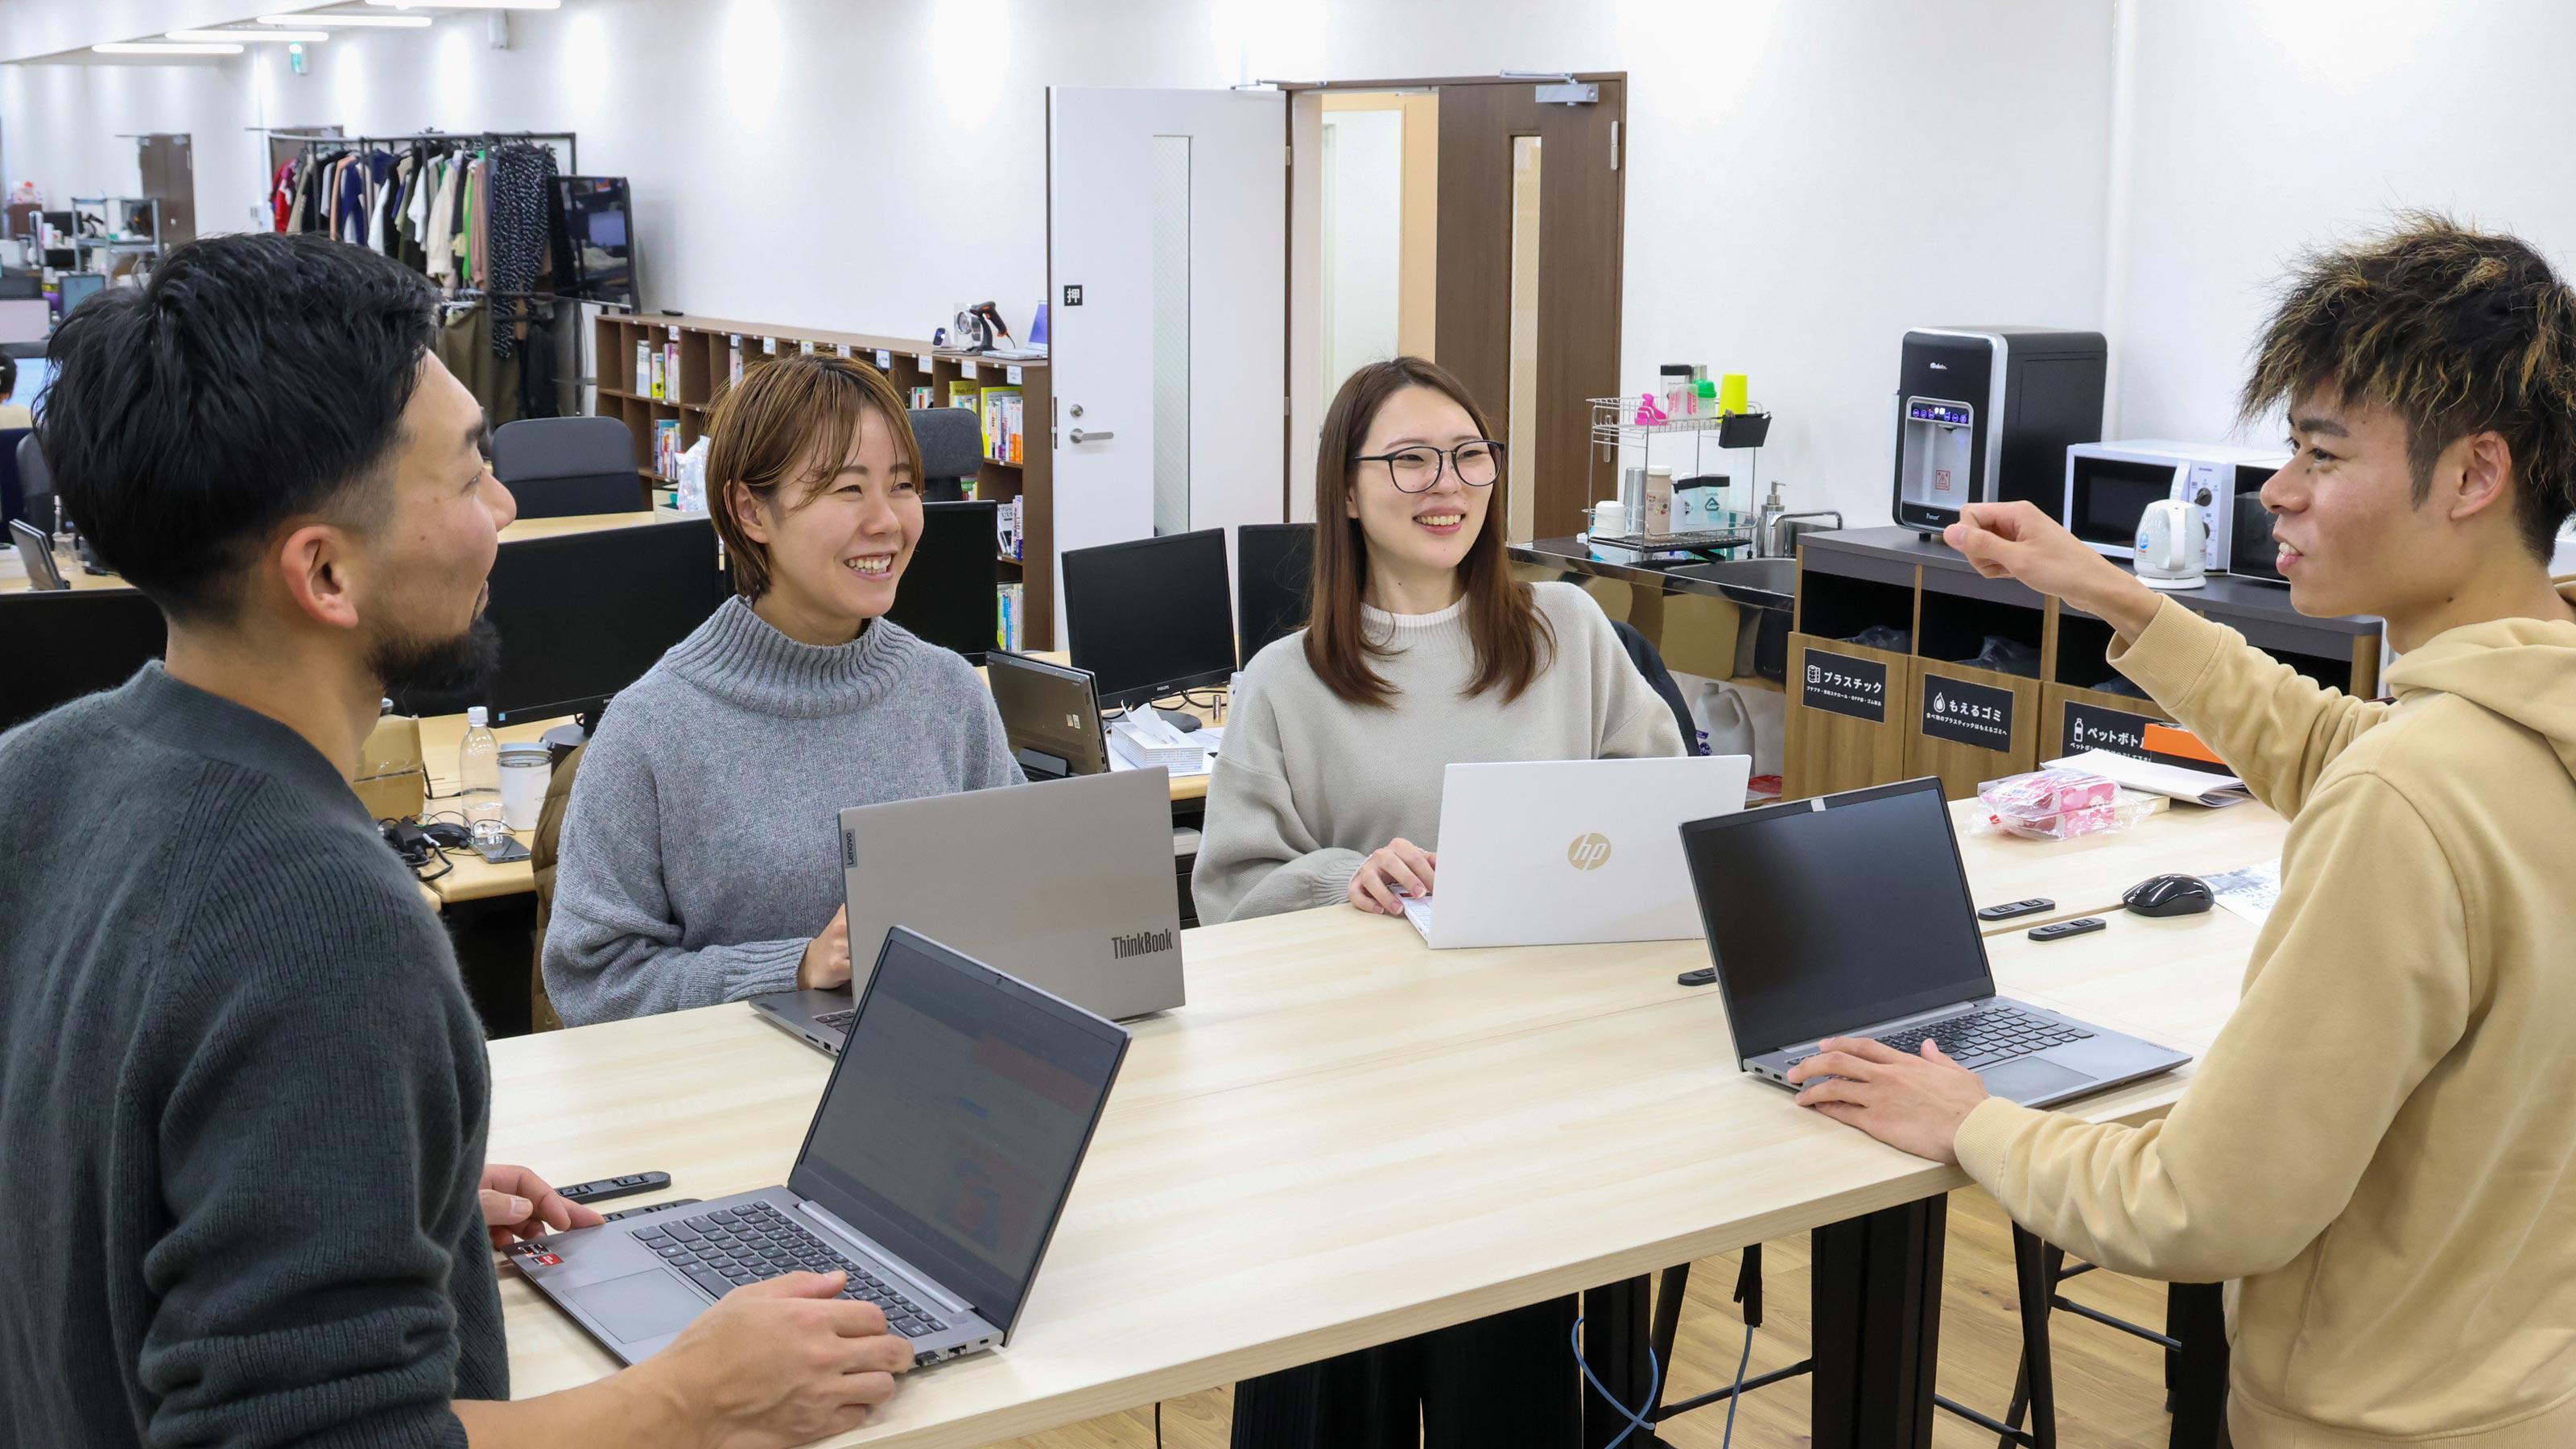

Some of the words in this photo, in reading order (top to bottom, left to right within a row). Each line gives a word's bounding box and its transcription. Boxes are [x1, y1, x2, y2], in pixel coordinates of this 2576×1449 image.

[1067, 288, 1080, 303] 押
[1824, 672, 1881, 693] プラスチック
[1950, 700, 2001, 721] もえるゴミ
[846, 832, 854, 865] Lenovo
[1572, 833, 1608, 870] hp
[1112, 927, 1173, 959] ThinkBook
